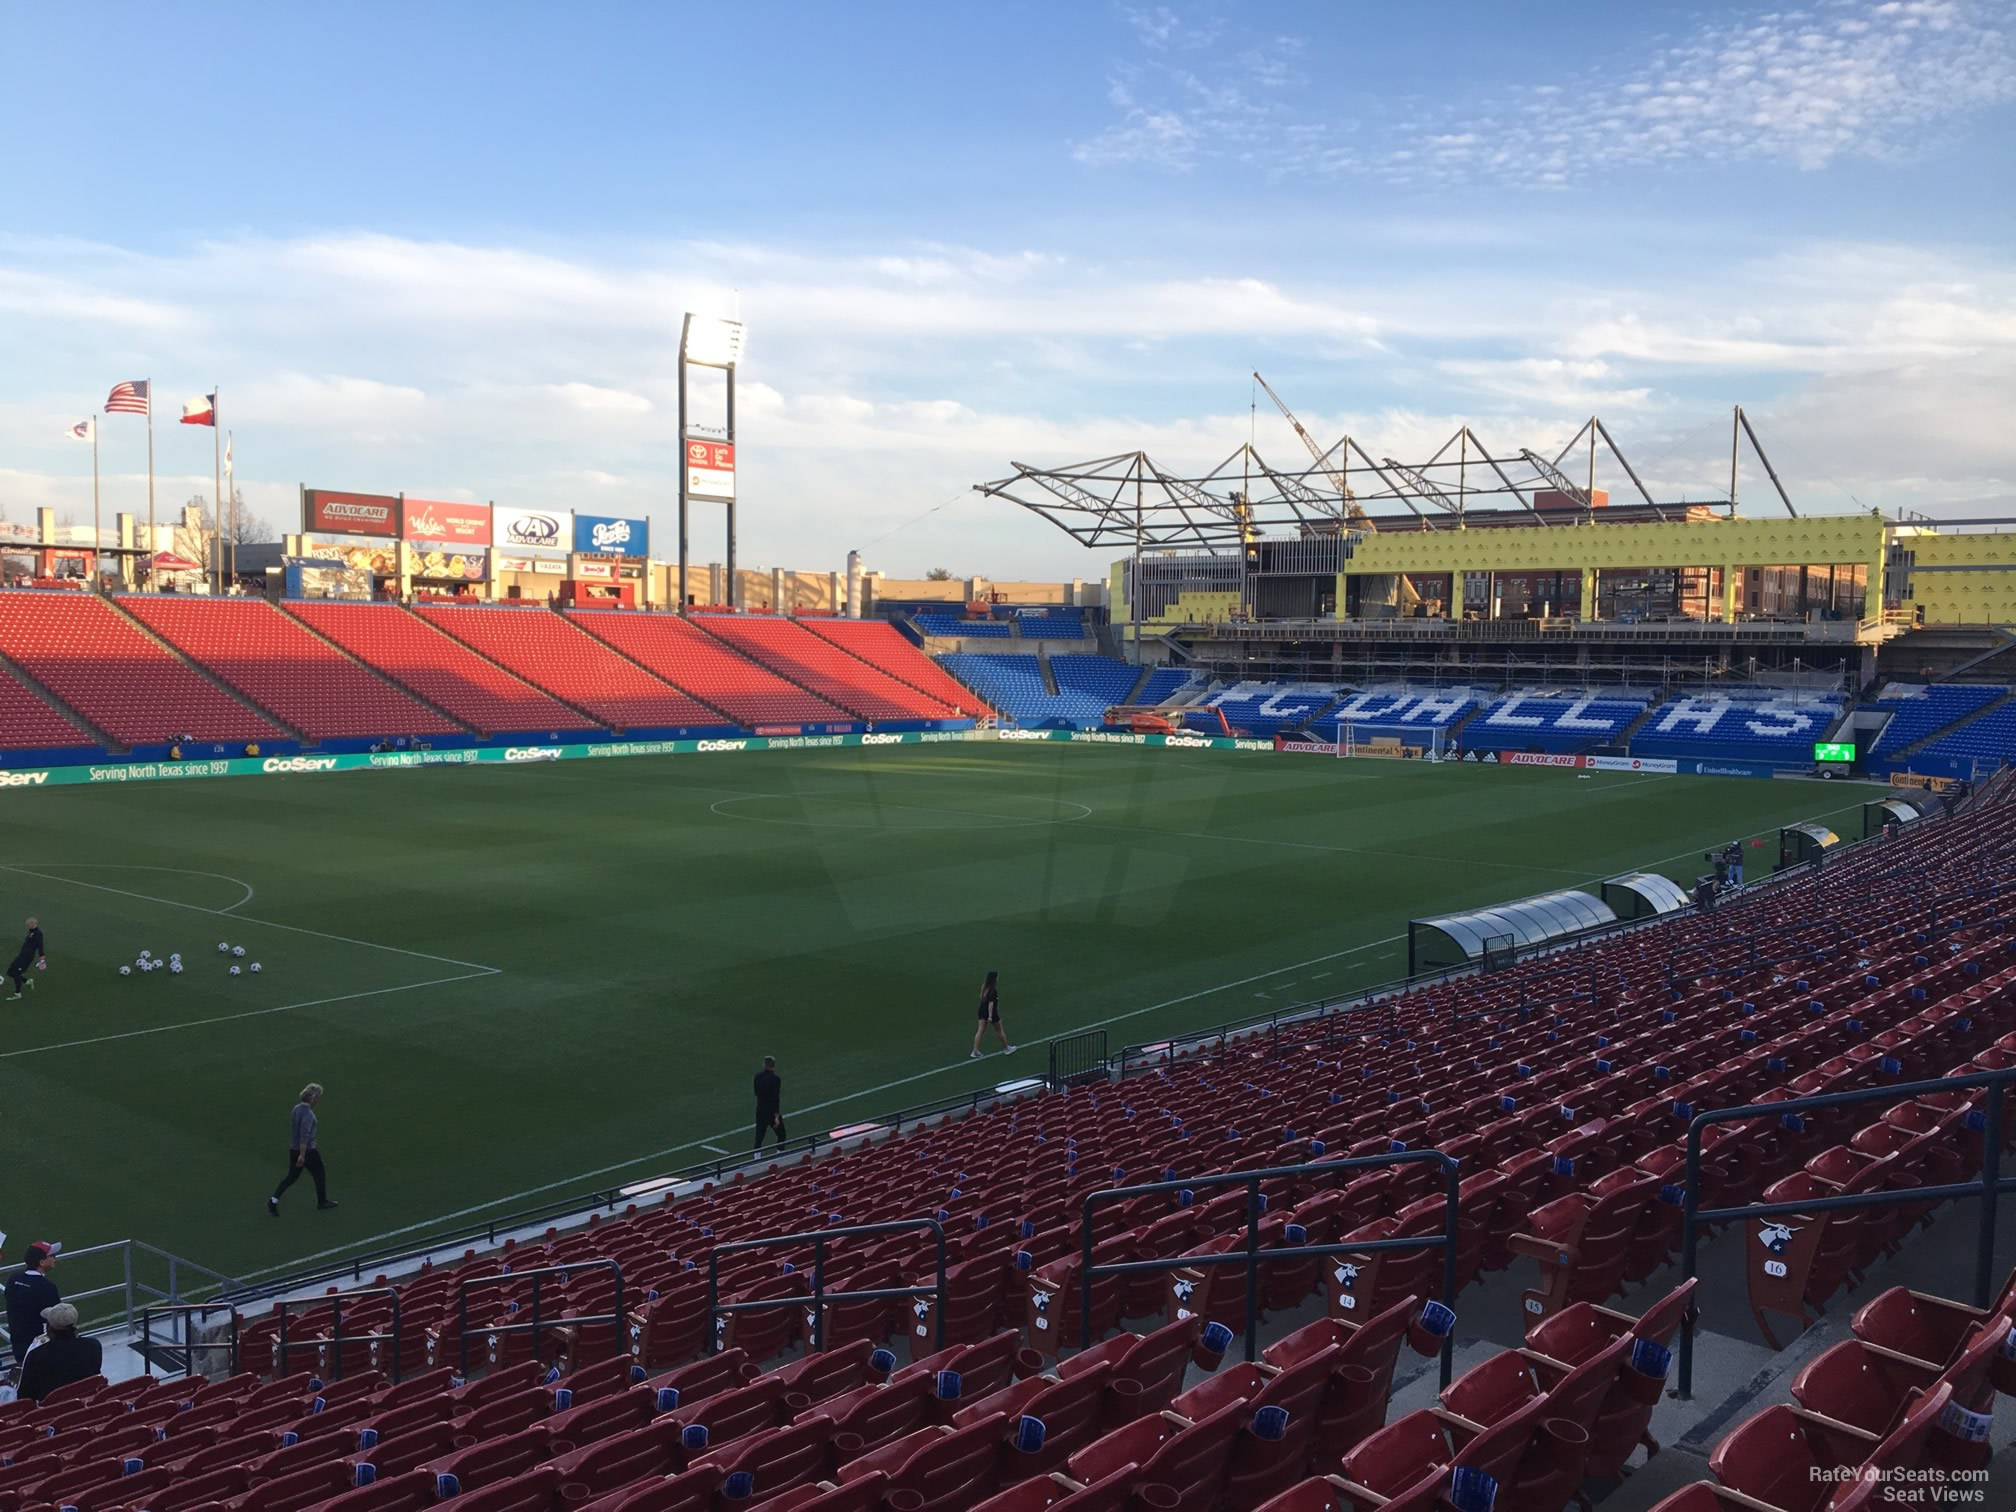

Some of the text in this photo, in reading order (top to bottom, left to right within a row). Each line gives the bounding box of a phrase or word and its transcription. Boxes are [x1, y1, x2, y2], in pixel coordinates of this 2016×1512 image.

[323, 502, 388, 519] ADVOCARE
[506, 534, 558, 546] ADVOCARE
[861, 733, 903, 744] CoServ
[999, 728, 1050, 740] CoServ
[1071, 732, 1146, 743] Serving North Texas since 1937
[697, 740, 746, 751] CoServ
[768, 735, 843, 748] Serving North Texas since 1937
[1165, 736, 1212, 748] CoServ
[1235, 740, 1274, 751] Serving North
[1284, 741, 1338, 753] ADVOCARE
[504, 747, 562, 760] CoServ
[587, 742, 674, 756] Serving North Texas since 1937
[369, 750, 478, 766] Serving North Texas since 1937
[1511, 753, 1575, 766] ADVOCARE
[263, 757, 336, 772] CoServ
[1597, 760, 1629, 769] MoneyGram
[1642, 762, 1676, 771] MoneyGram
[90, 761, 228, 781] Serving North Texas since 1937
[1703, 766, 1753, 776] UnitedHealthcare
[1769, 1263, 1783, 1274] 16
[1342, 1297, 1352, 1306] 14
[1530, 1301, 1540, 1311] 15
